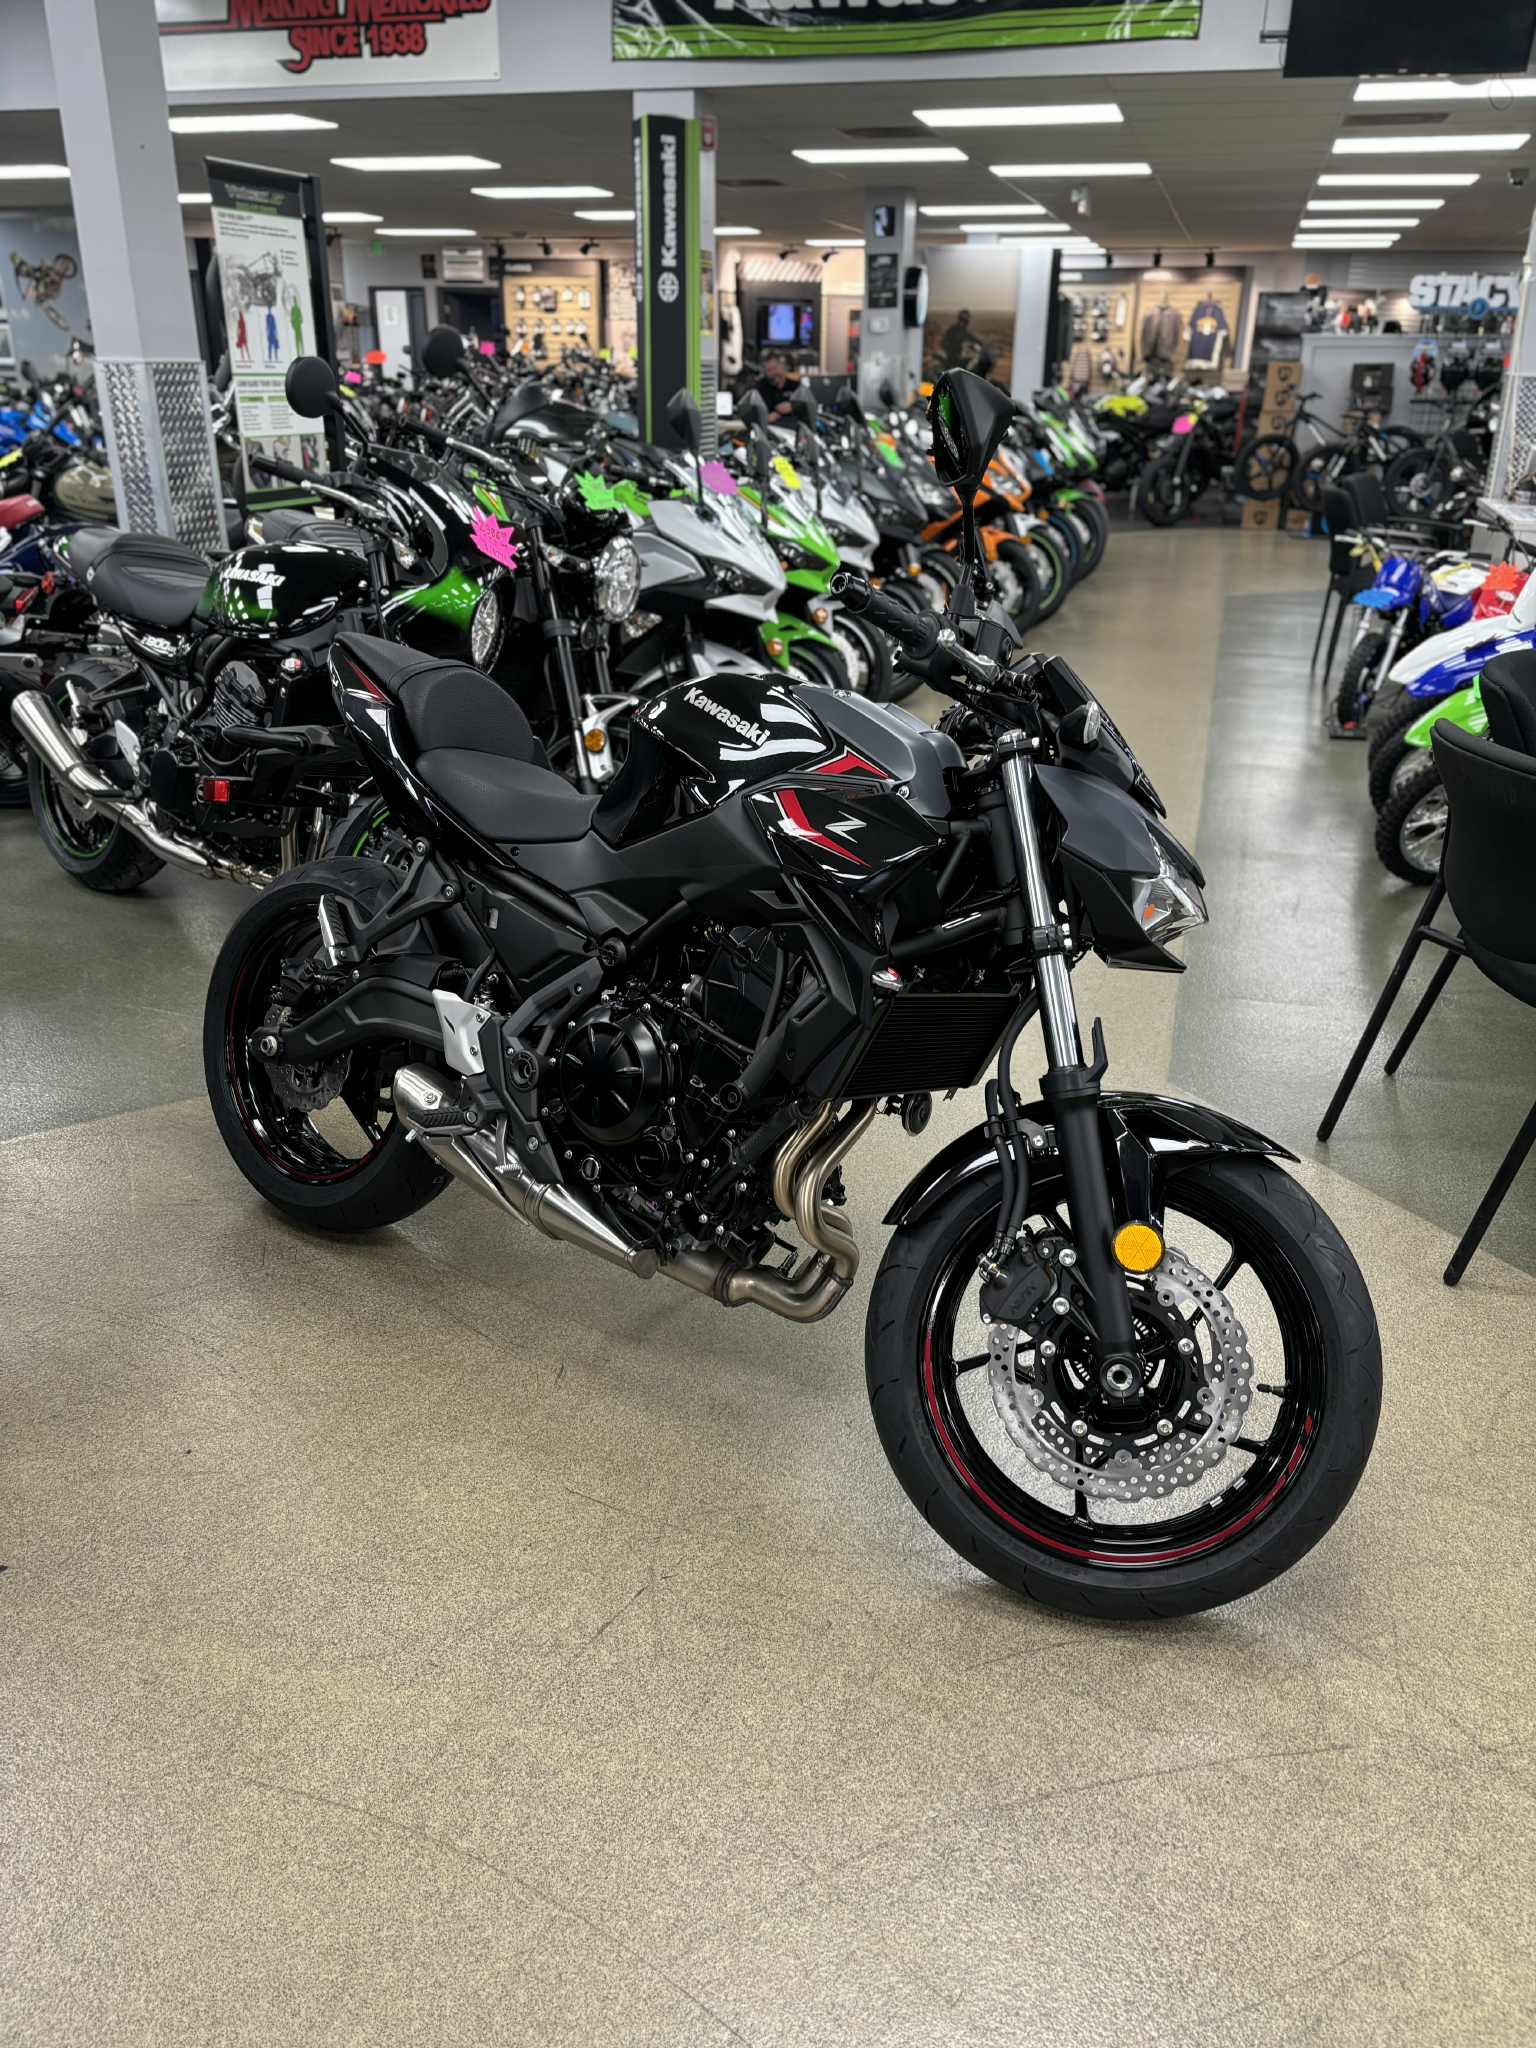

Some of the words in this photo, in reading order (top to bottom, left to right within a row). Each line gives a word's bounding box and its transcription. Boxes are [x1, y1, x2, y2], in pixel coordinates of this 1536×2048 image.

[286, 26, 361, 72] SINCE
[366, 23, 426, 55] 1938
[660, 134, 677, 267] Kawasaki
[683, 687, 770, 746] Kawasaki
